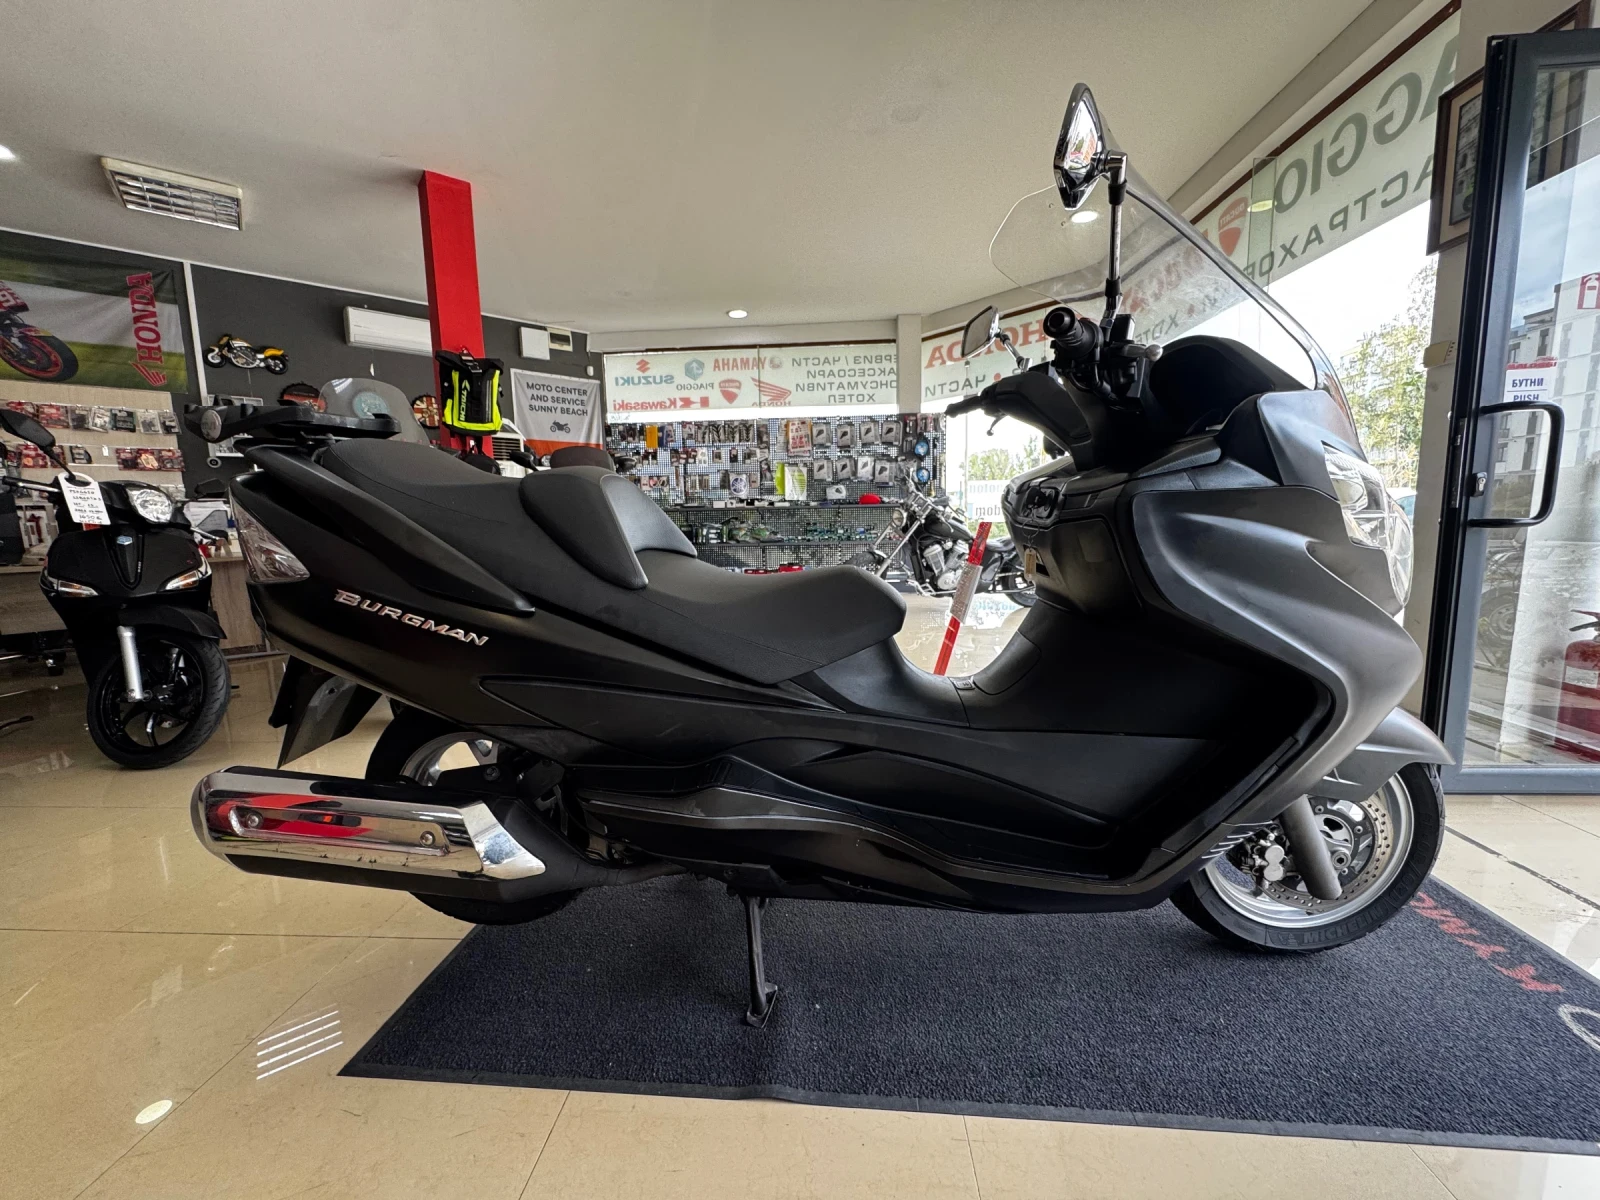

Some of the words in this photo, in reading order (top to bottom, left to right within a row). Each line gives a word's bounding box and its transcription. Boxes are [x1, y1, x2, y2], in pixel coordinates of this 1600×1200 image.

[127, 271, 164, 365] HONDA
[526, 382, 552, 392] MOTO
[554, 385, 588, 397] CENTER
[1511, 377, 1544, 388] БУТНИ
[459, 389, 467, 421] TAICHI
[530, 394, 548, 403] AND
[551, 396, 586, 406] SERVICE
[1513, 393, 1540, 402] PUSH
[528, 404, 558, 413] SUNNY
[560, 407, 588, 416] BEACH
[334, 588, 489, 646] BURGMAN
[1303, 904, 1384, 945] MICHELIN
